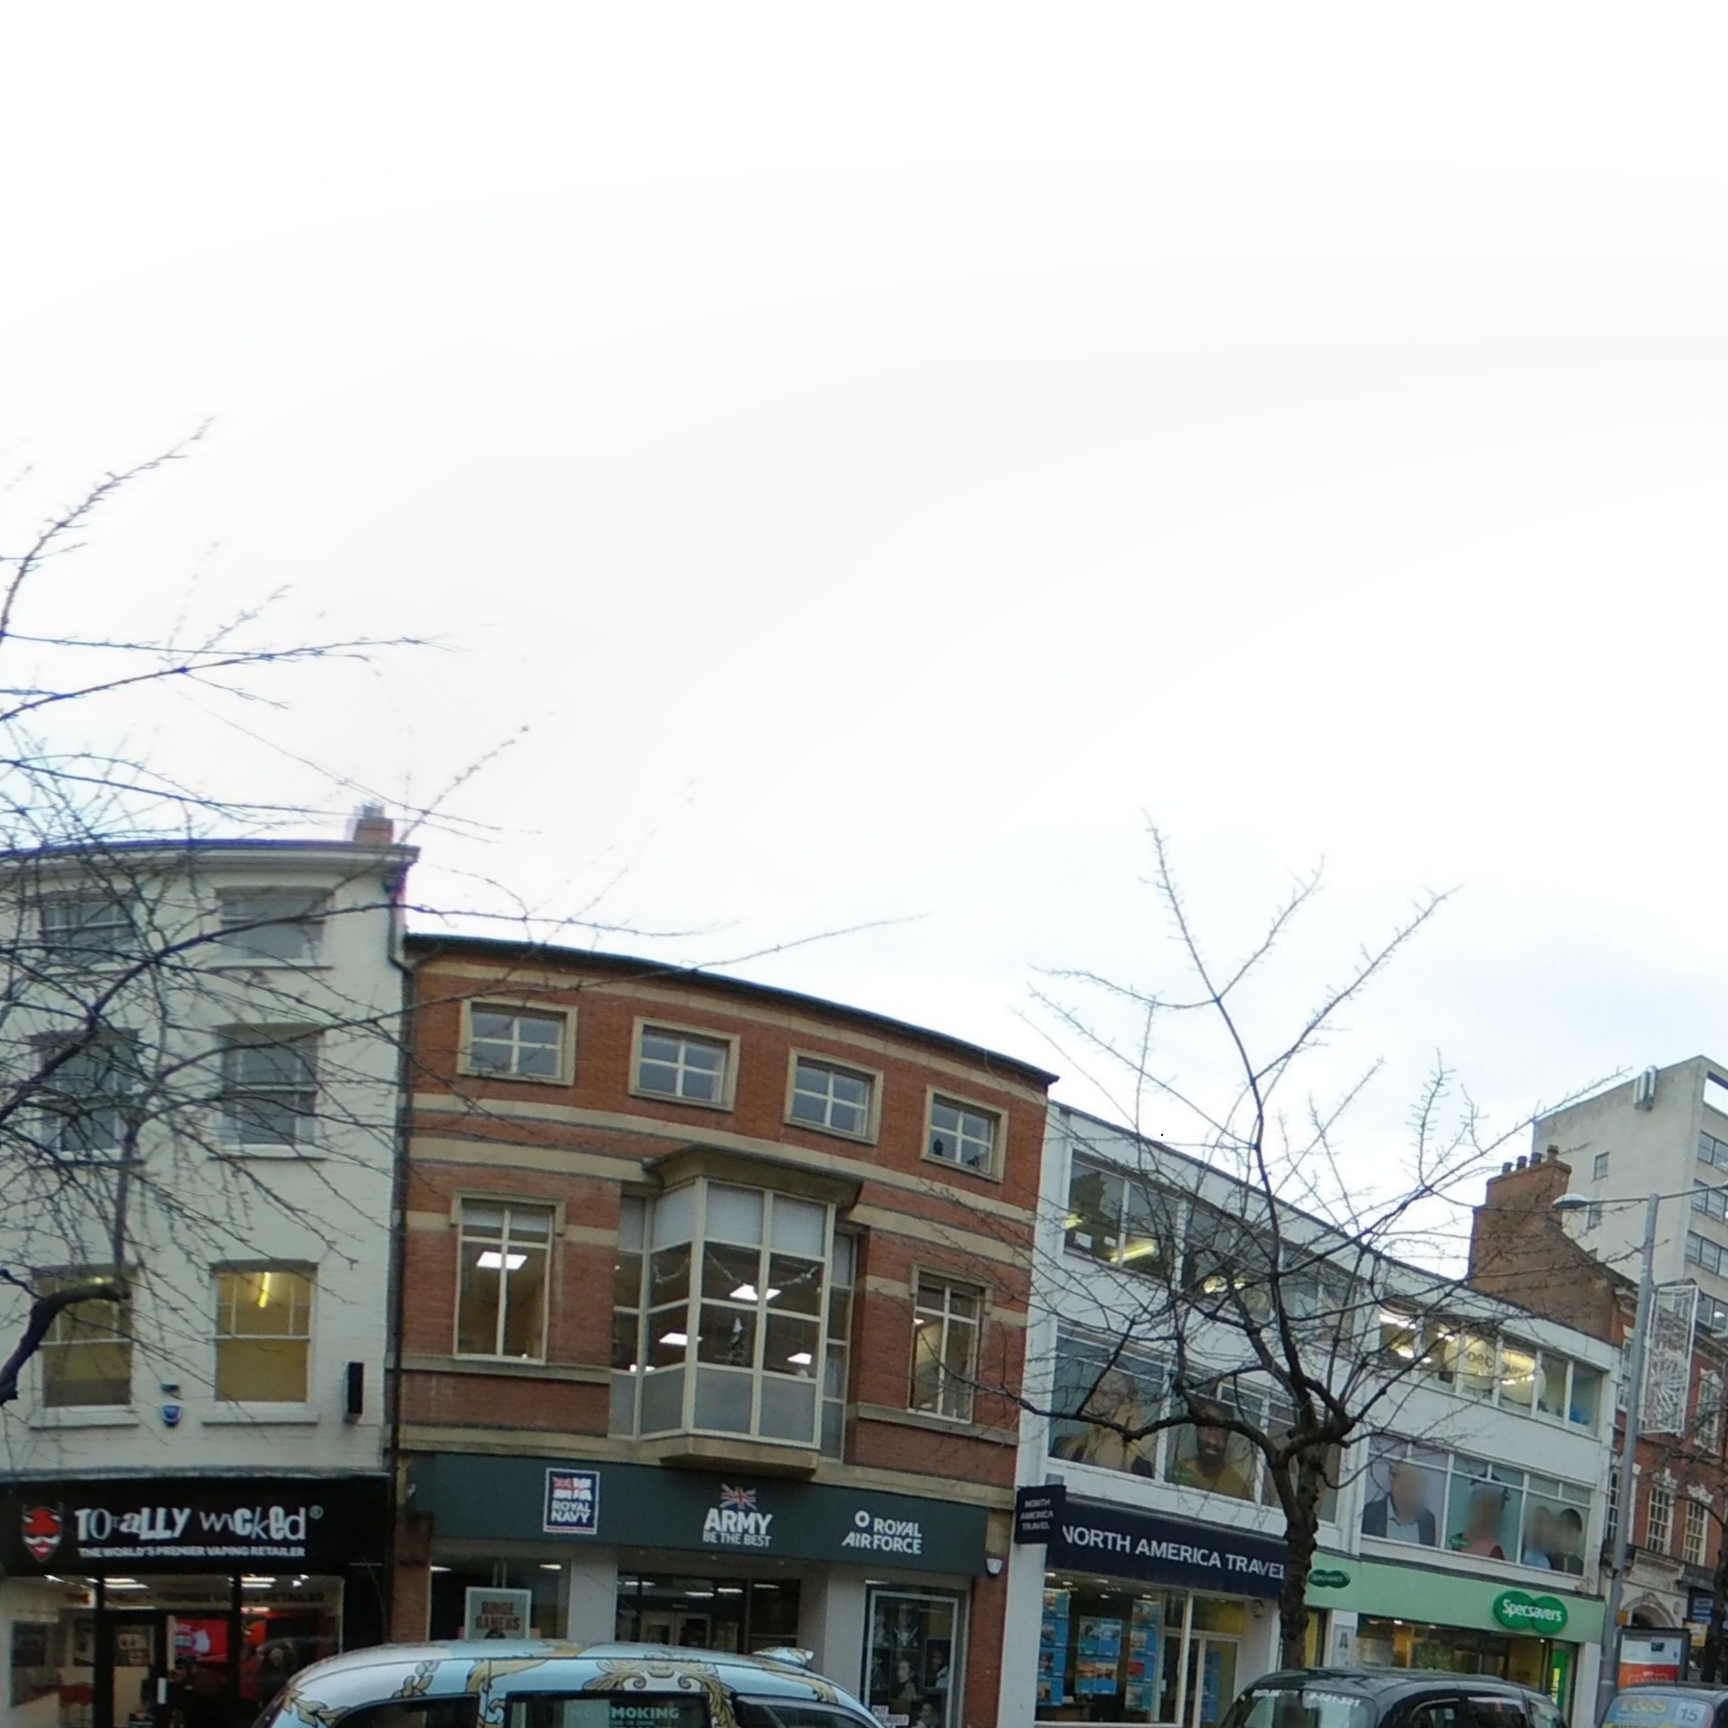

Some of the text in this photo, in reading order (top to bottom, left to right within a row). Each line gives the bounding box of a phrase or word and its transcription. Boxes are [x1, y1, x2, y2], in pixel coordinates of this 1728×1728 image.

[552, 1500, 592, 1513] ROYAL
[1020, 1509, 1055, 1521] AMERICA
[550, 1509, 591, 1524] NAVY
[703, 1507, 774, 1535] ARMY
[873, 1517, 923, 1538] ROYAL
[702, 1530, 772, 1548] BE THE BEST
[841, 1531, 923, 1555] AIR FORCE
[1062, 1524, 1132, 1553] NORTH
[1135, 1537, 1222, 1569] AMERICA
[1502, 1598, 1563, 1624] Specsavers
[1680, 1707, 1699, 1723] 15
